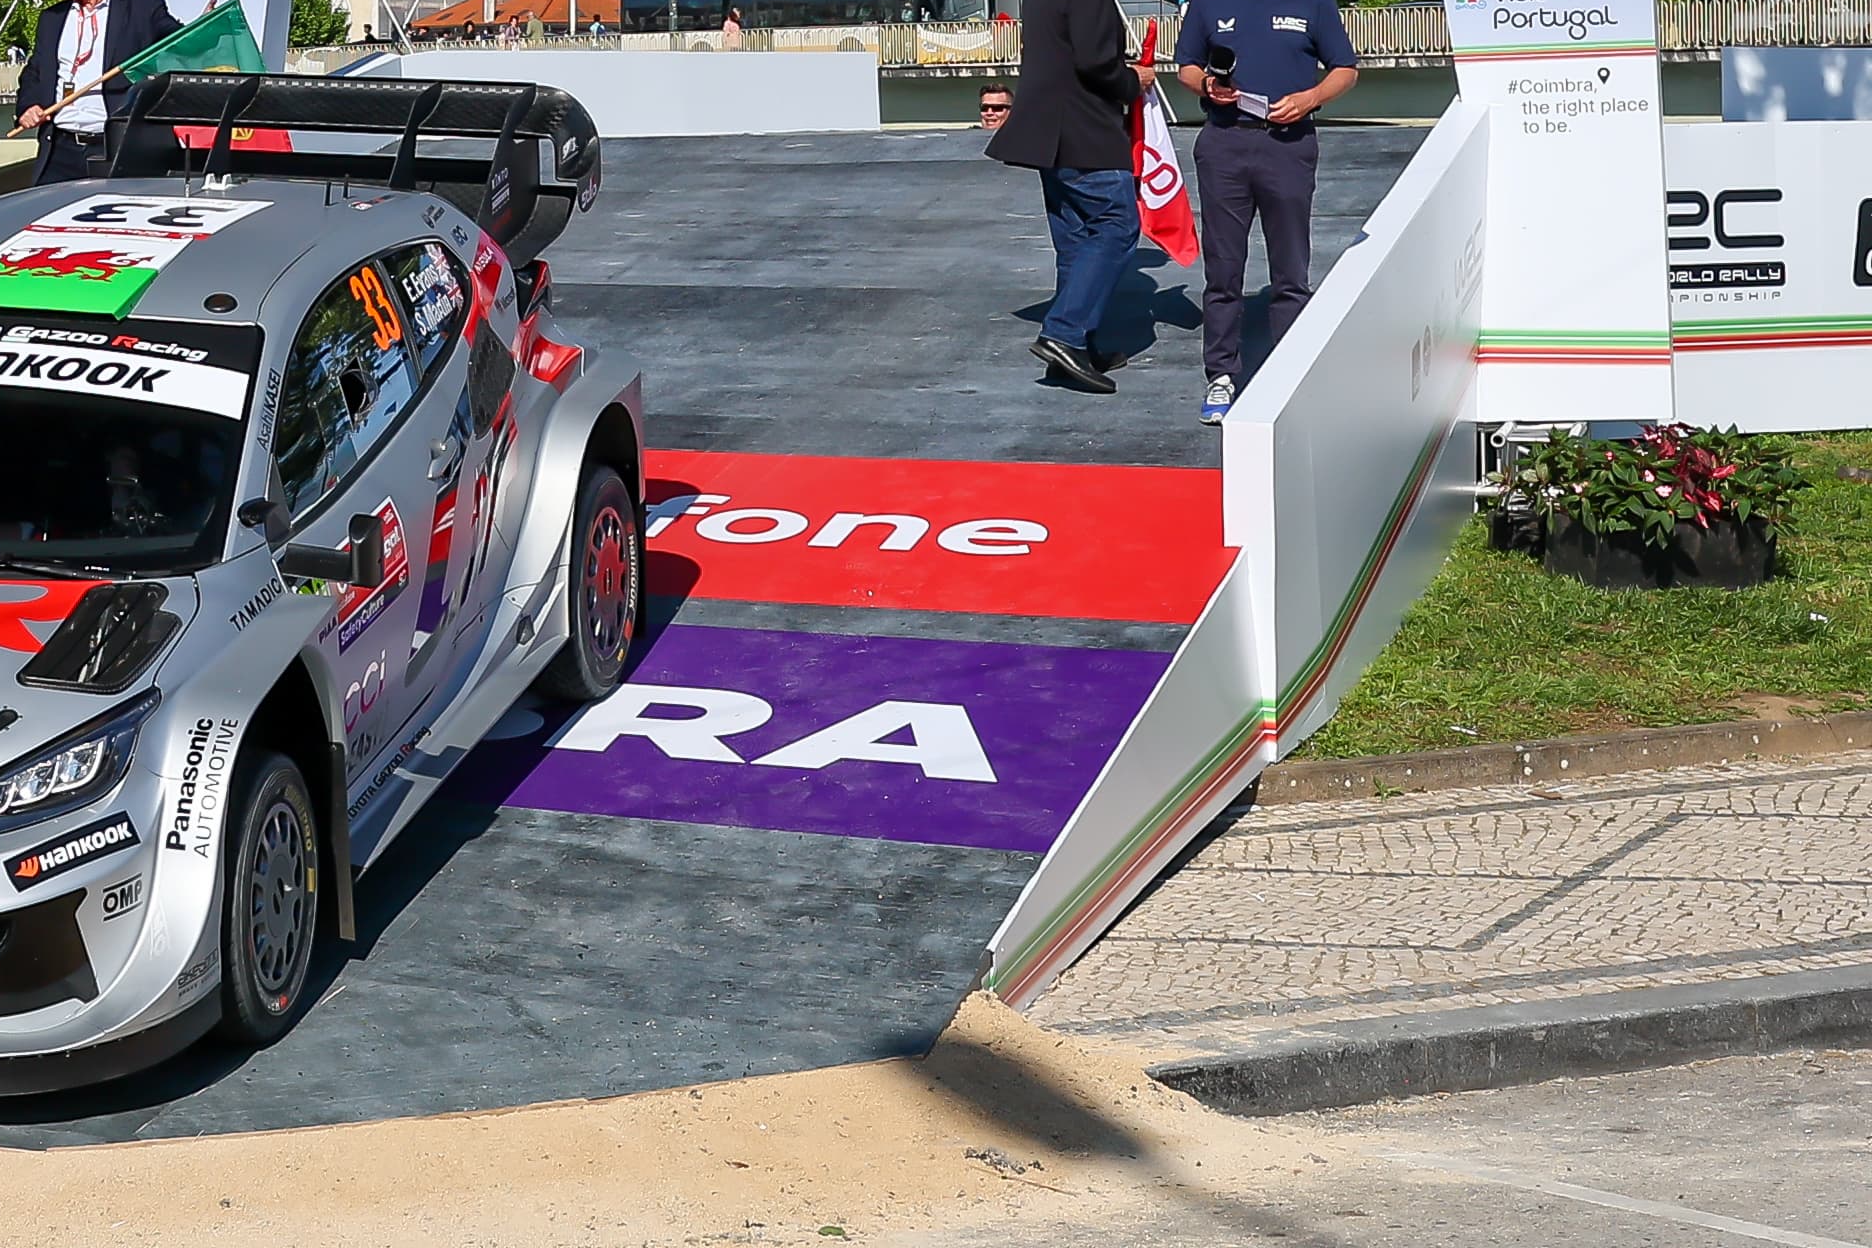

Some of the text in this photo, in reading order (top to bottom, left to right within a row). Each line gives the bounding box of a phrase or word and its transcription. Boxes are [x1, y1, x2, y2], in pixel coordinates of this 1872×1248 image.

[1272, 15, 1308, 27] WRC
[1493, 5, 1618, 40] Portugal
[1521, 97, 1649, 118] the right place
[1523, 118, 1572, 135] to be.
[1667, 188, 1785, 250] RC
[1719, 268, 1782, 283] RALLY
[349, 265, 402, 351] 33
[1670, 290, 1782, 304] PIONSHIP
[2, 325, 109, 346] GAZOO
[110, 334, 210, 363] Racing
[646, 493, 1050, 557] fone
[229, 577, 282, 633] TAMADIC
[340, 594, 385, 646] SafetyCulture
[165, 716, 215, 852] Panasonic
[193, 717, 239, 859] AUTOMOTIVE
[102, 879, 143, 914] OMP
